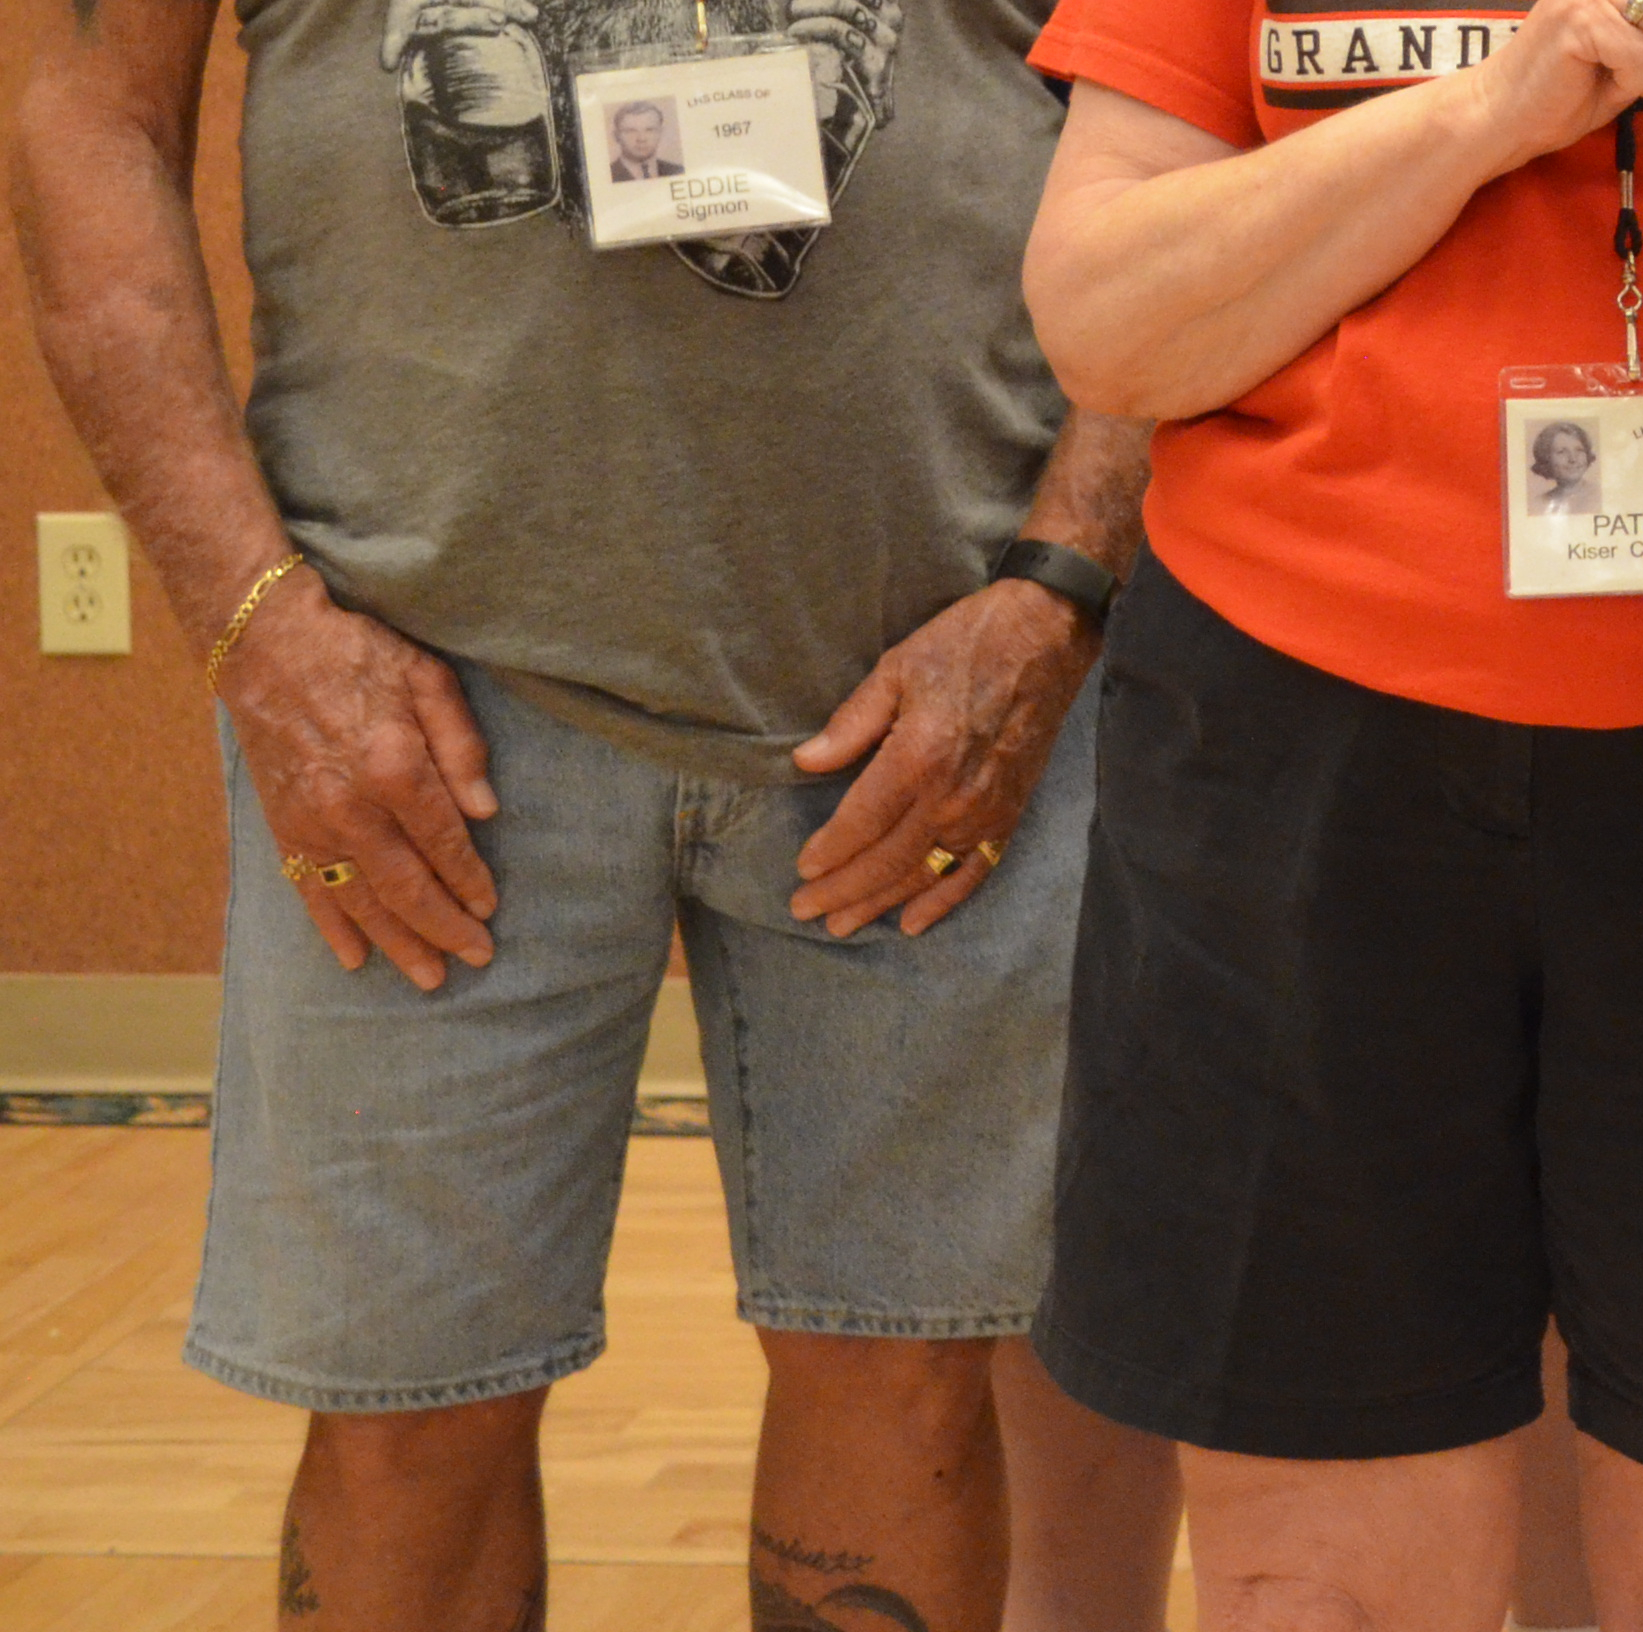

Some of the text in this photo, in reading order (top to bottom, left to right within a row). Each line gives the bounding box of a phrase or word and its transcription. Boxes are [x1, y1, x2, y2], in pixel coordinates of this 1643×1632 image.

[1266, 24, 1522, 76] GRAND
[712, 89, 752, 103] CLASS
[711, 119, 752, 139] 1967
[669, 172, 751, 202] EDDIE
[675, 198, 749, 222] Sigmon
[1567, 541, 1618, 560] Kiser
